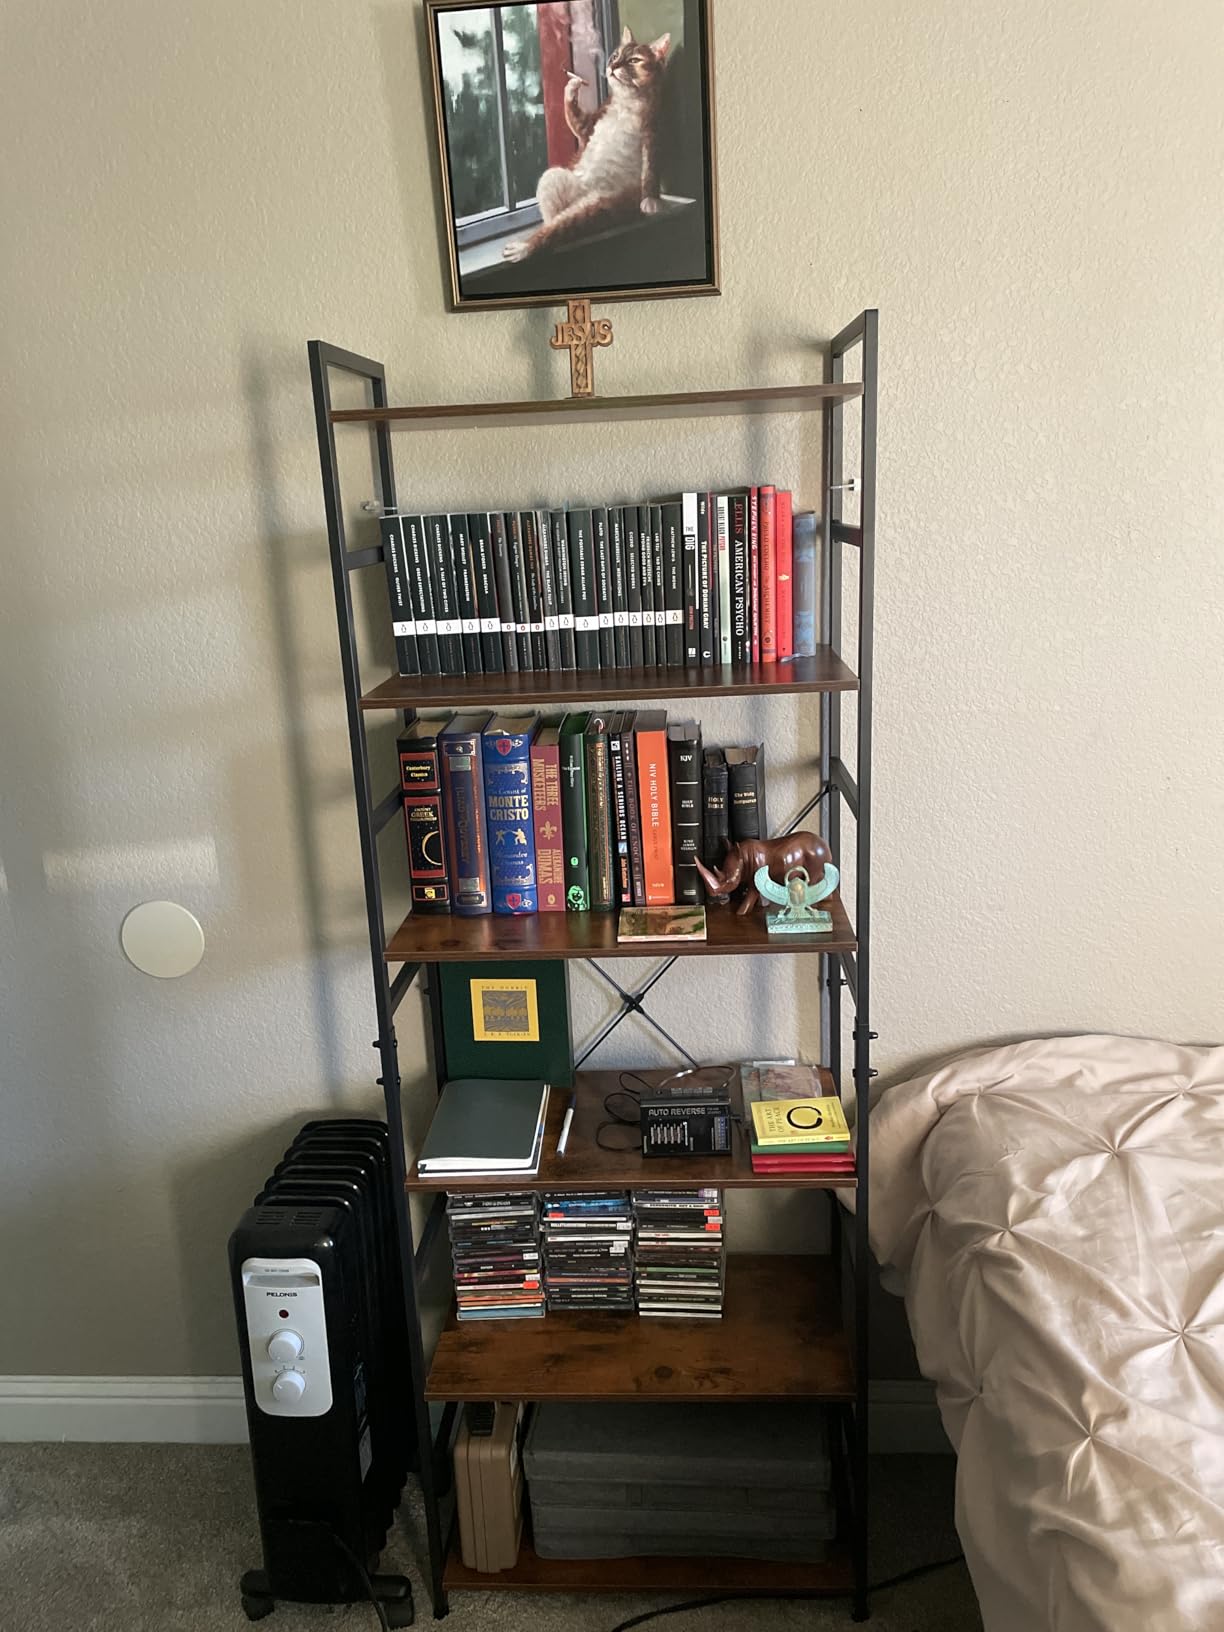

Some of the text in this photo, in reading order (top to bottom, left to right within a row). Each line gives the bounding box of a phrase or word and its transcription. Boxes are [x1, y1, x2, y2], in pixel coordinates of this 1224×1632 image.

[549, 318, 614, 349] JESUS
[684, 536, 695, 550] DIG
[734, 504, 744, 636] ELLIS AMERICAN PSYCHO
[614, 756, 624, 782] SAILING
[648, 762, 657, 778] NIV
[532, 758, 546, 812] MUSKETEERS
[546, 764, 558, 806] THE THREE
[650, 780, 658, 801] HOLY
[488, 794, 529, 808] MONTE
[616, 791, 626, 818] SERIOUS
[489, 808, 530, 821] CRISTO
[651, 803, 660, 828] BIBLE
[618, 820, 627, 840] OCEAN
[631, 836, 640, 864] ENOCH
[537, 848, 552, 885] DUMAS
[552, 848, 563, 884] ALEXANDRE
[648, 1108, 669, 1116] AUTO
[670, 1107, 706, 1116] REVERSE
